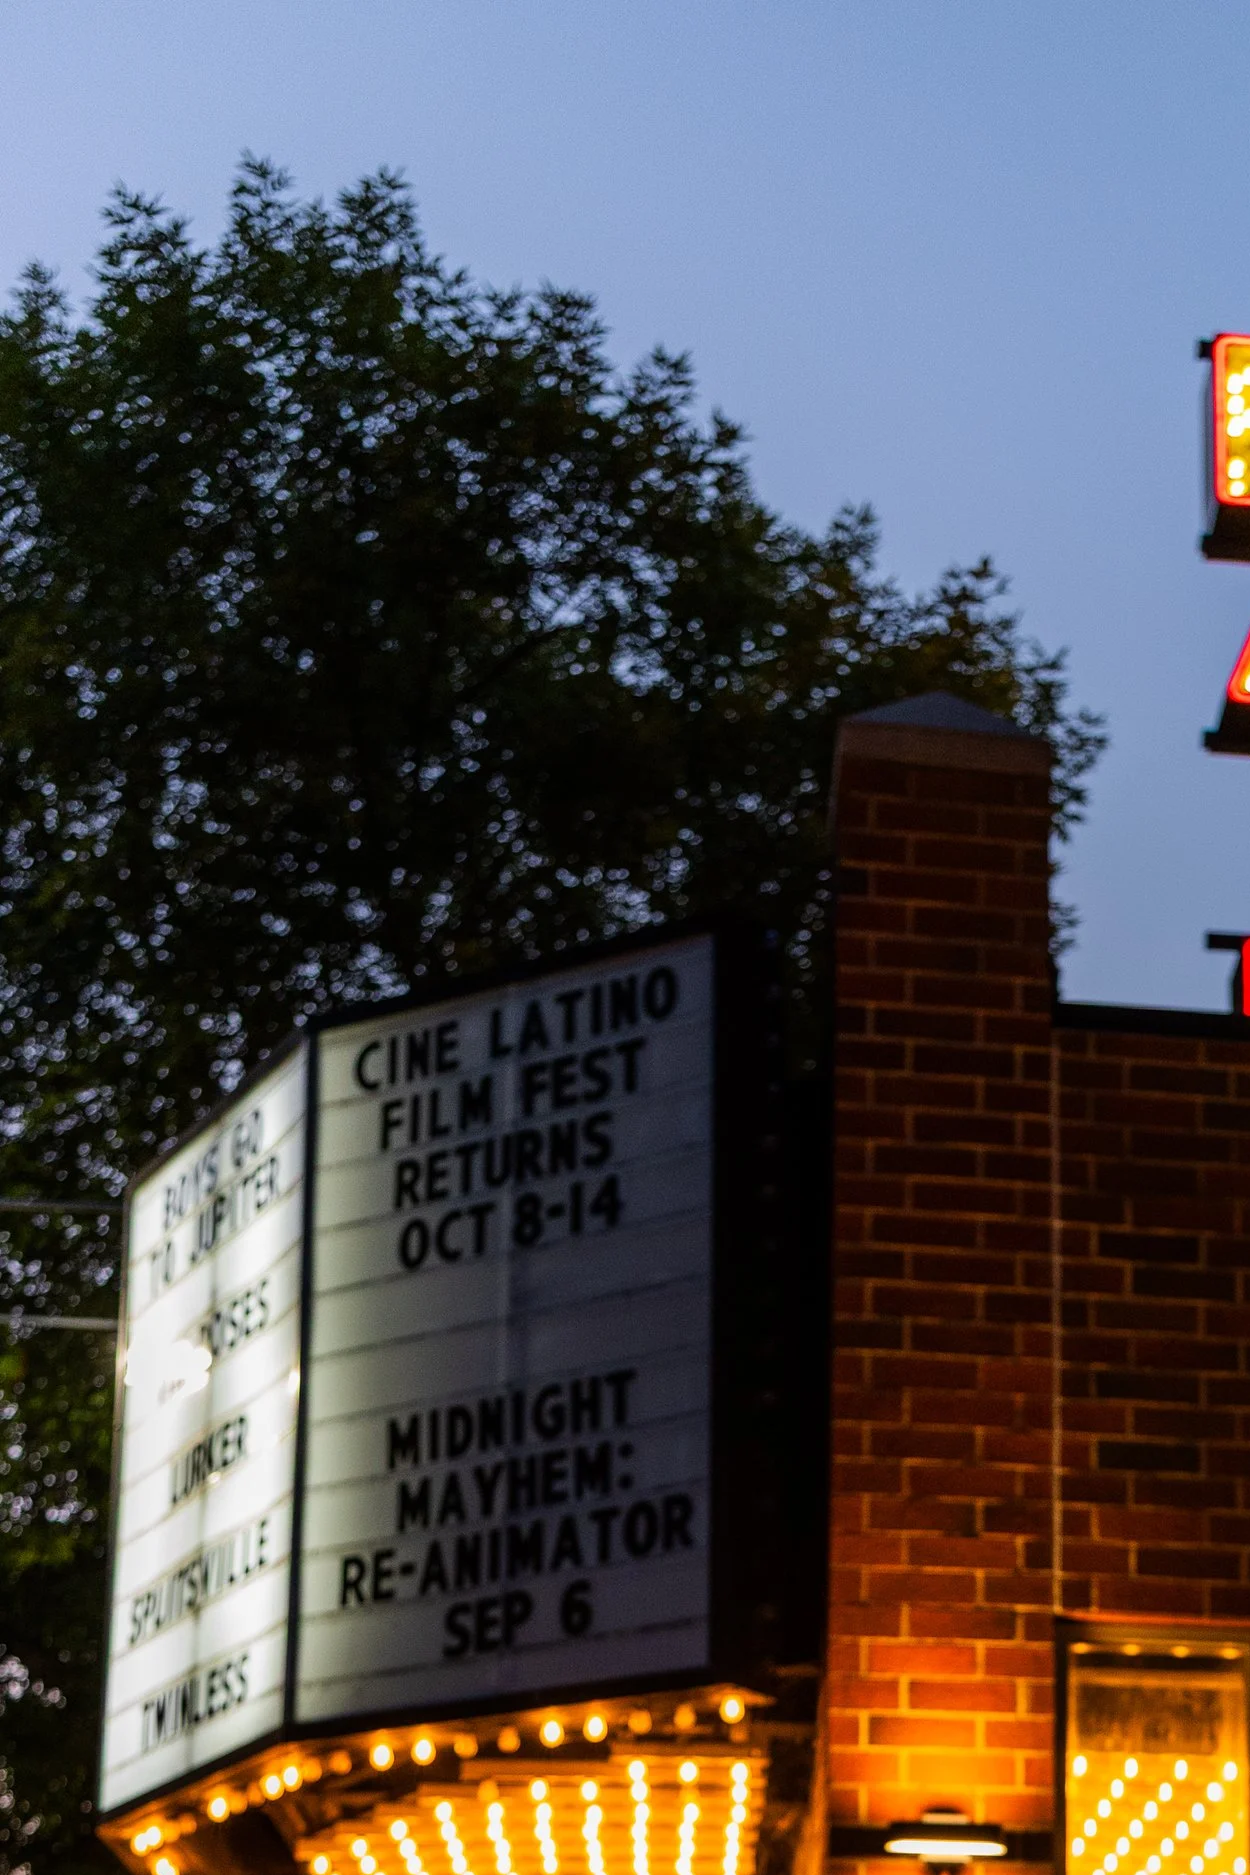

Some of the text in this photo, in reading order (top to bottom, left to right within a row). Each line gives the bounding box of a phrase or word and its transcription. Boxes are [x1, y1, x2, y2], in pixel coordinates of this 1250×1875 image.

[355, 965, 678, 1092] CINE LATINO
[381, 1035, 647, 1150] FILM FEST
[163, 1108, 264, 1232] BOYS GO
[190, 1155, 281, 1266] JUPITER
[394, 1109, 614, 1211] RETURNS
[398, 1173, 621, 1271] OCT 8-14
[170, 1414, 248, 1506] LURKER
[386, 1368, 638, 1472] MIDNIGHT
[396, 1441, 634, 1535] MAYHEM:
[128, 1517, 270, 1647] SPLITSVILLE
[340, 1492, 694, 1609] RE-ANIMATOR
[442, 1578, 594, 1661] SEP 6
[140, 1654, 251, 1755] TWINLESS
